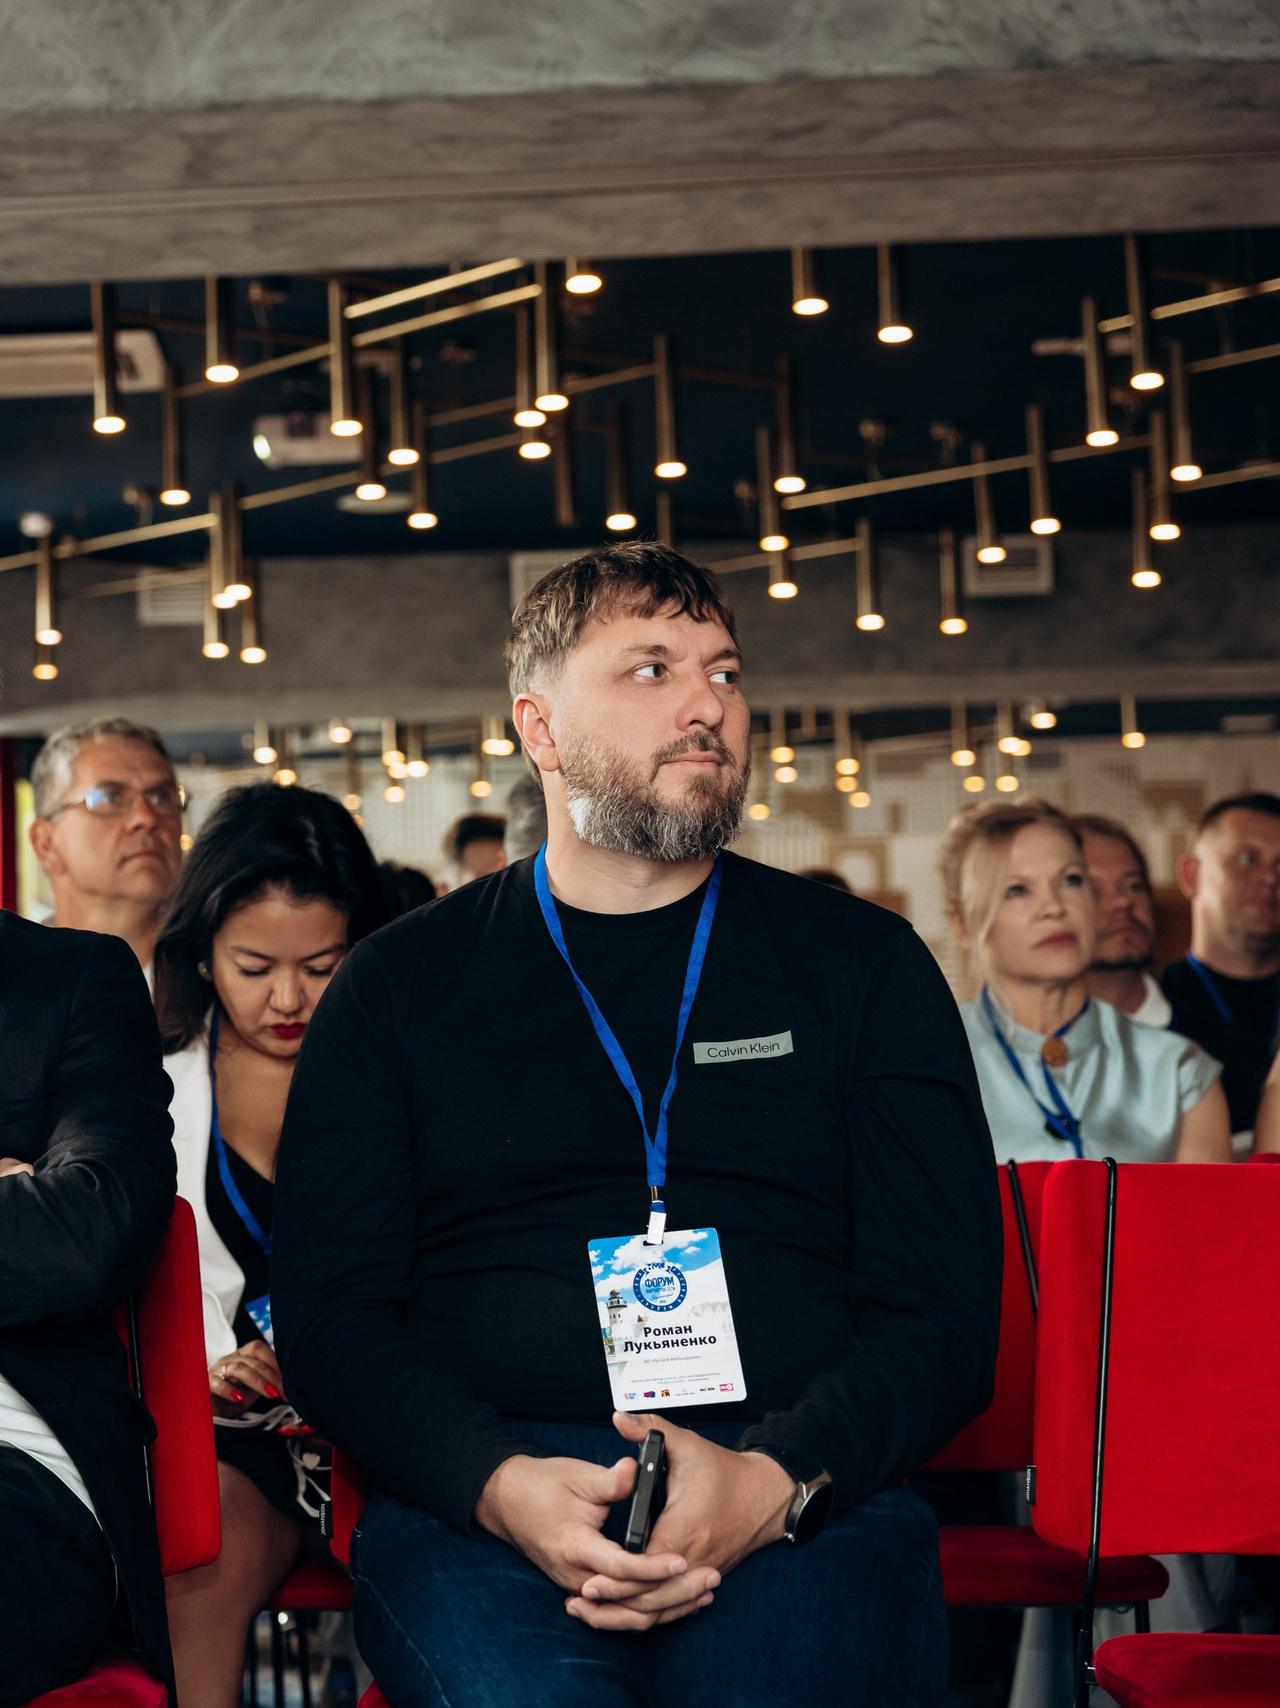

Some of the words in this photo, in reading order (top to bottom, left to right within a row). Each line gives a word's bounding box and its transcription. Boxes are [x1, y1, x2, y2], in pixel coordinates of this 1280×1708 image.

[707, 1046, 748, 1058] Calvin
[749, 1042, 780, 1054] Klein
[644, 1276, 675, 1288] ФОРУМ
[643, 1325, 693, 1337] Роман
[623, 1335, 717, 1354] Лукьяненко
